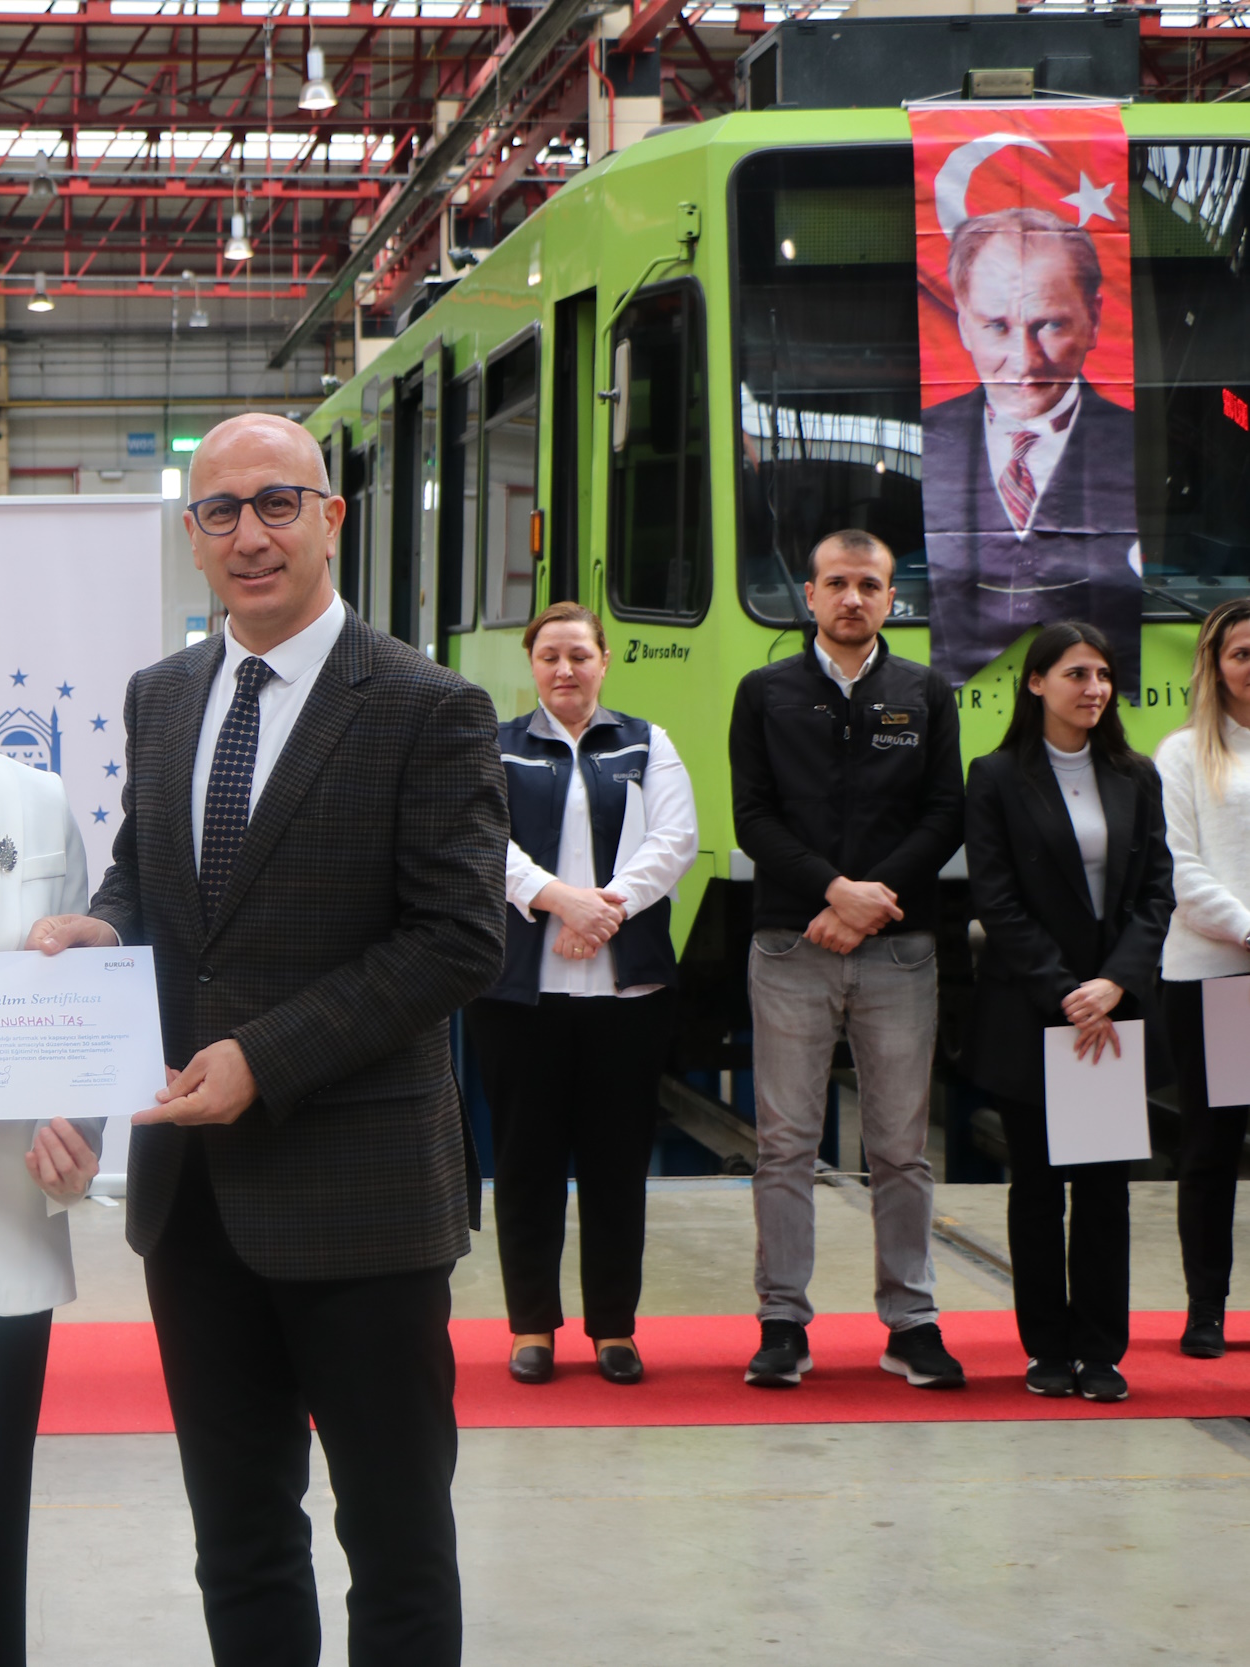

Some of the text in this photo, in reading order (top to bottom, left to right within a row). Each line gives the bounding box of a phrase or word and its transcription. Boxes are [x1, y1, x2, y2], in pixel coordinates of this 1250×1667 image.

[642, 643, 690, 662] BursaRay
[872, 734, 918, 748] BURULAŞ
[30, 993, 102, 1006] Sertifikası
[1, 1015, 84, 1027] NURHAN TAŞ
